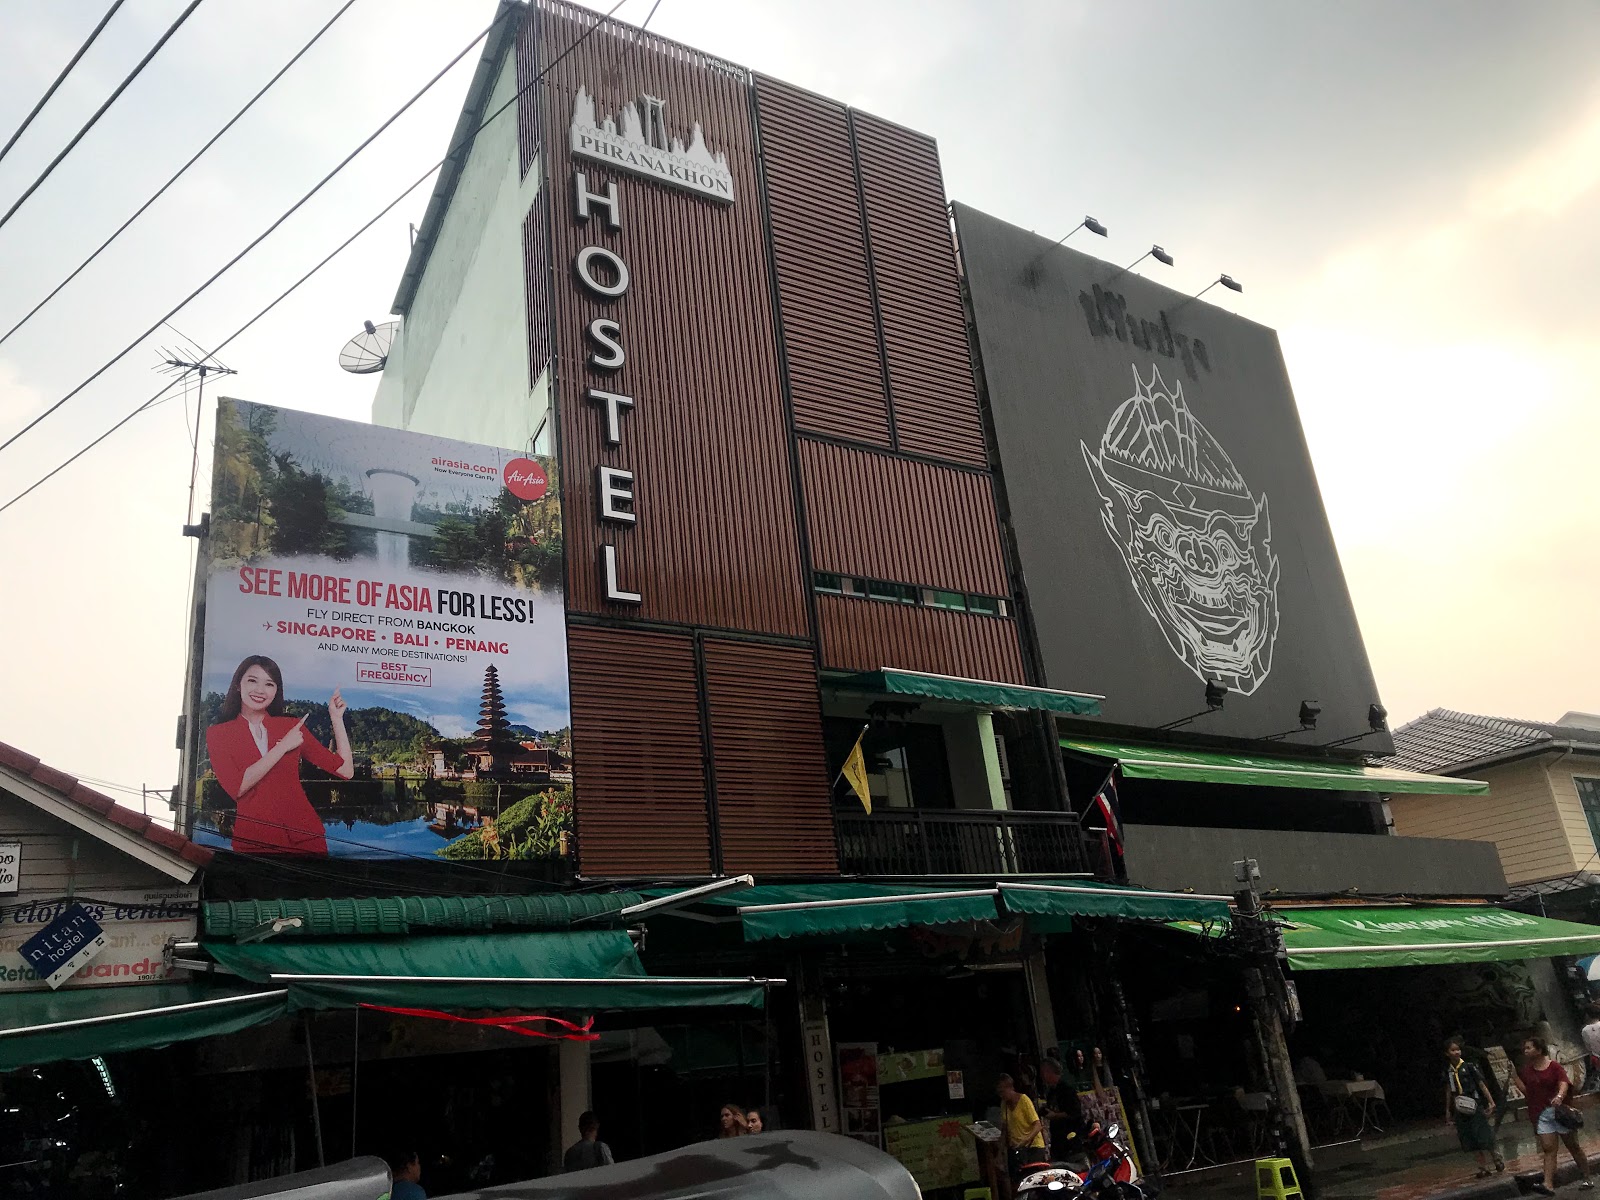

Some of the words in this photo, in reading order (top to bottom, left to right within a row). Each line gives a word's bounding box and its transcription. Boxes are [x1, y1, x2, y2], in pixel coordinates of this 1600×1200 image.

[580, 134, 728, 195] PHRANAKHON
[574, 171, 642, 603] HOSTEL
[431, 456, 498, 475] airasia.com
[434, 466, 447, 474] Now
[448, 468, 473, 479] Everyone
[486, 474, 495, 482] Fly
[239, 566, 282, 597] SEE
[287, 571, 350, 605] MORE
[356, 579, 383, 608] OF
[386, 583, 433, 614] ASIA
[437, 589, 475, 618] FOR
[480, 593, 535, 624] LESS!
[307, 608, 327, 620] FLY
[331, 610, 374, 624] DIRECT
[378, 615, 414, 629] FROM
[417, 620, 476, 635] BANGKOK
[276, 620, 376, 642] SINGAPORE
[393, 632, 429, 648] BALI
[446, 638, 509, 655] PENANG
[317, 642, 331, 652] AND
[341, 644, 370, 655] MANY
[371, 647, 399, 658] MORE
[401, 649, 468, 663] DESTINATIONS!
[381, 661, 408, 673] BEST
[360, 669, 429, 684] FREQUENCY
[13, 899, 104, 923] clotes
[30, 914, 87, 962] nitan
[48, 931, 85, 963] hostel
[811, 1034, 831, 1129] HOSTEL
